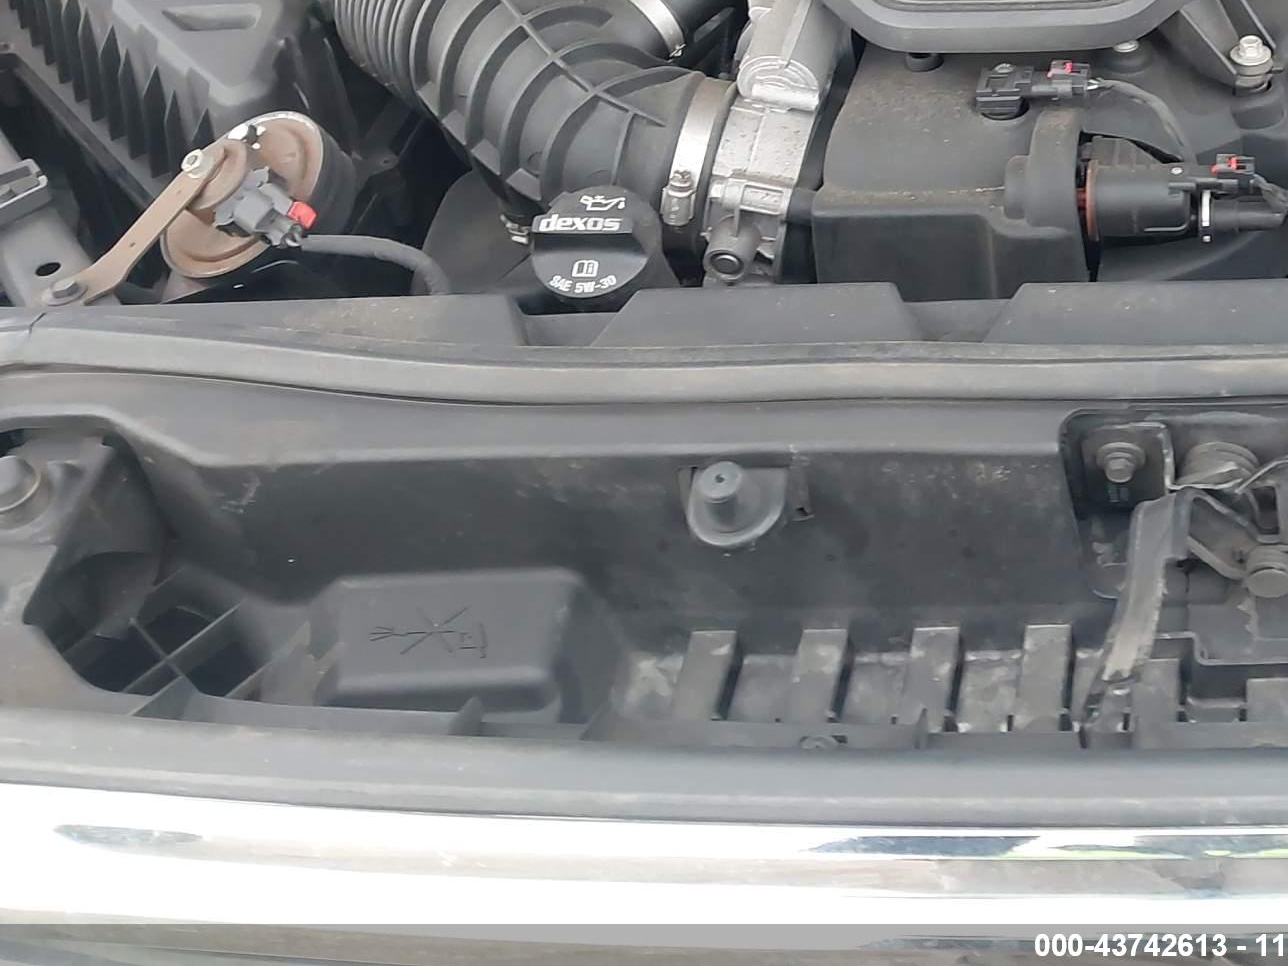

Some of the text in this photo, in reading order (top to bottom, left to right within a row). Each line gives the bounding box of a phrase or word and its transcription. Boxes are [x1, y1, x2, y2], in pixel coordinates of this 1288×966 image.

[539, 214, 622, 232] dexos
[549, 275, 617, 293] SAE 5W-30
